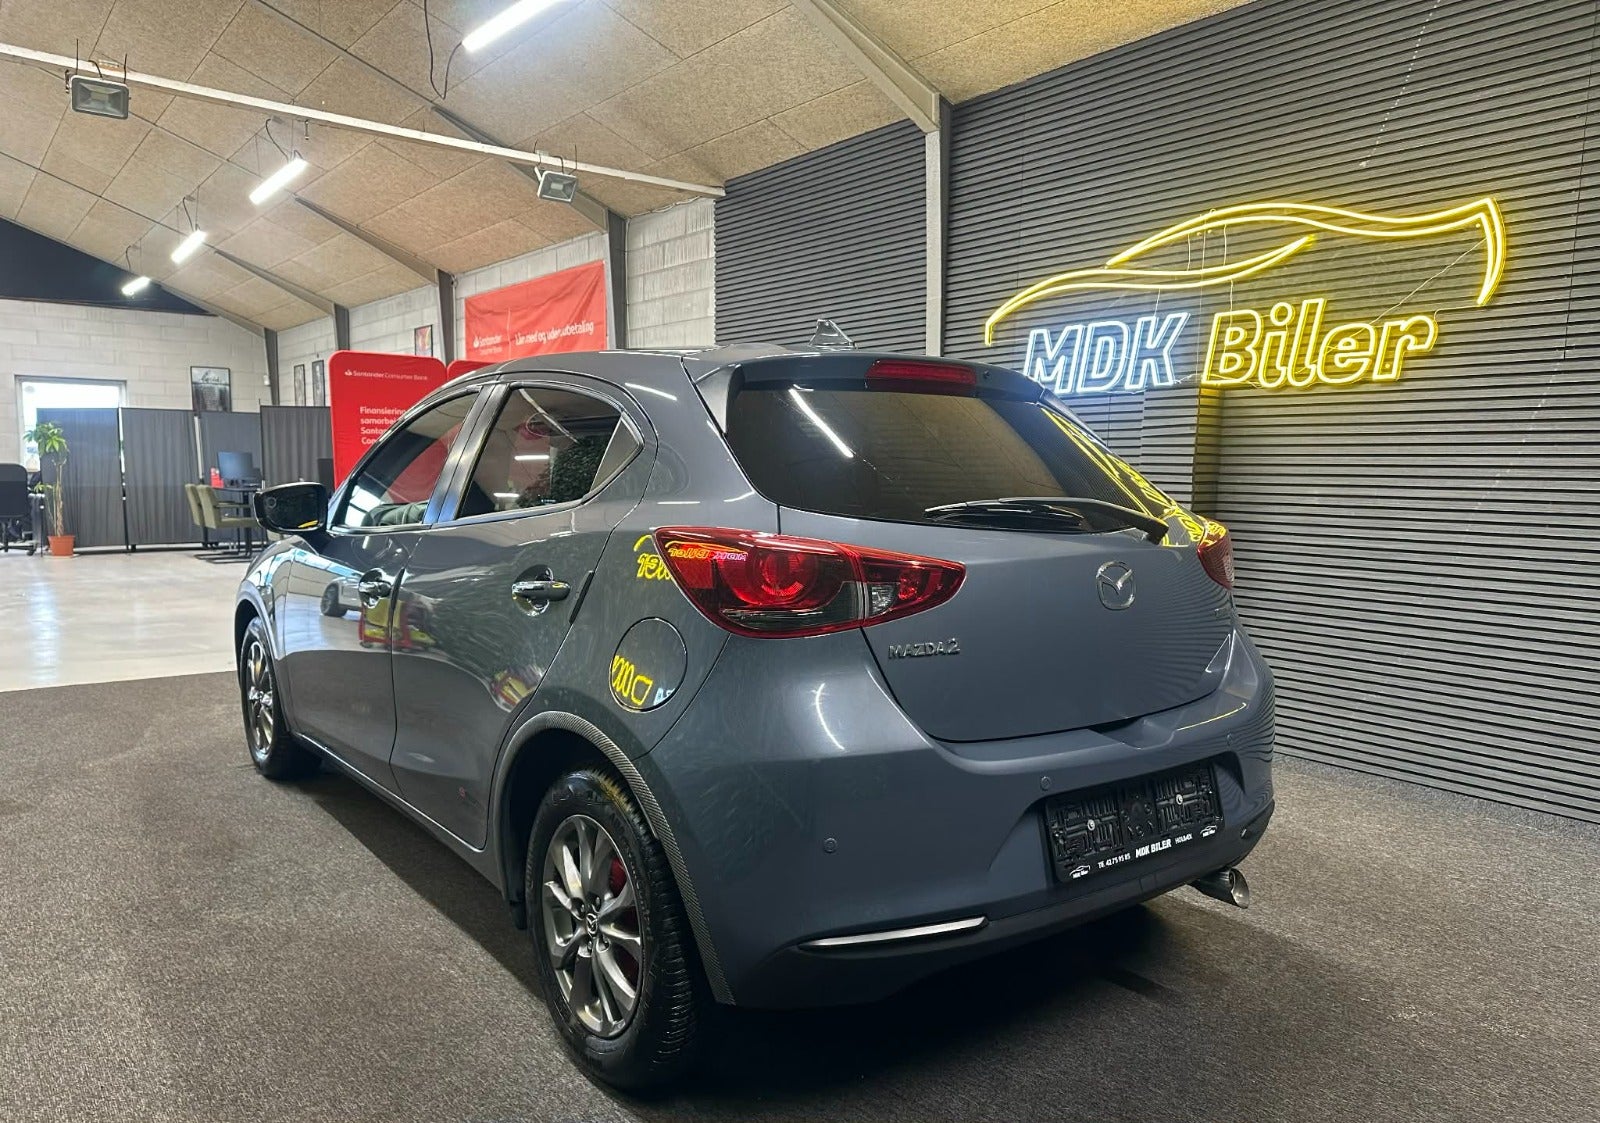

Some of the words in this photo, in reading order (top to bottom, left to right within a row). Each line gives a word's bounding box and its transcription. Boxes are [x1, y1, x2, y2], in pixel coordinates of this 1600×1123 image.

[1023, 311, 1191, 395] MDK
[1202, 298, 1439, 387] Biler
[353, 370, 385, 378] Santander
[1135, 845, 1150, 858] MDK
[1150, 838, 1172, 854] BILER
